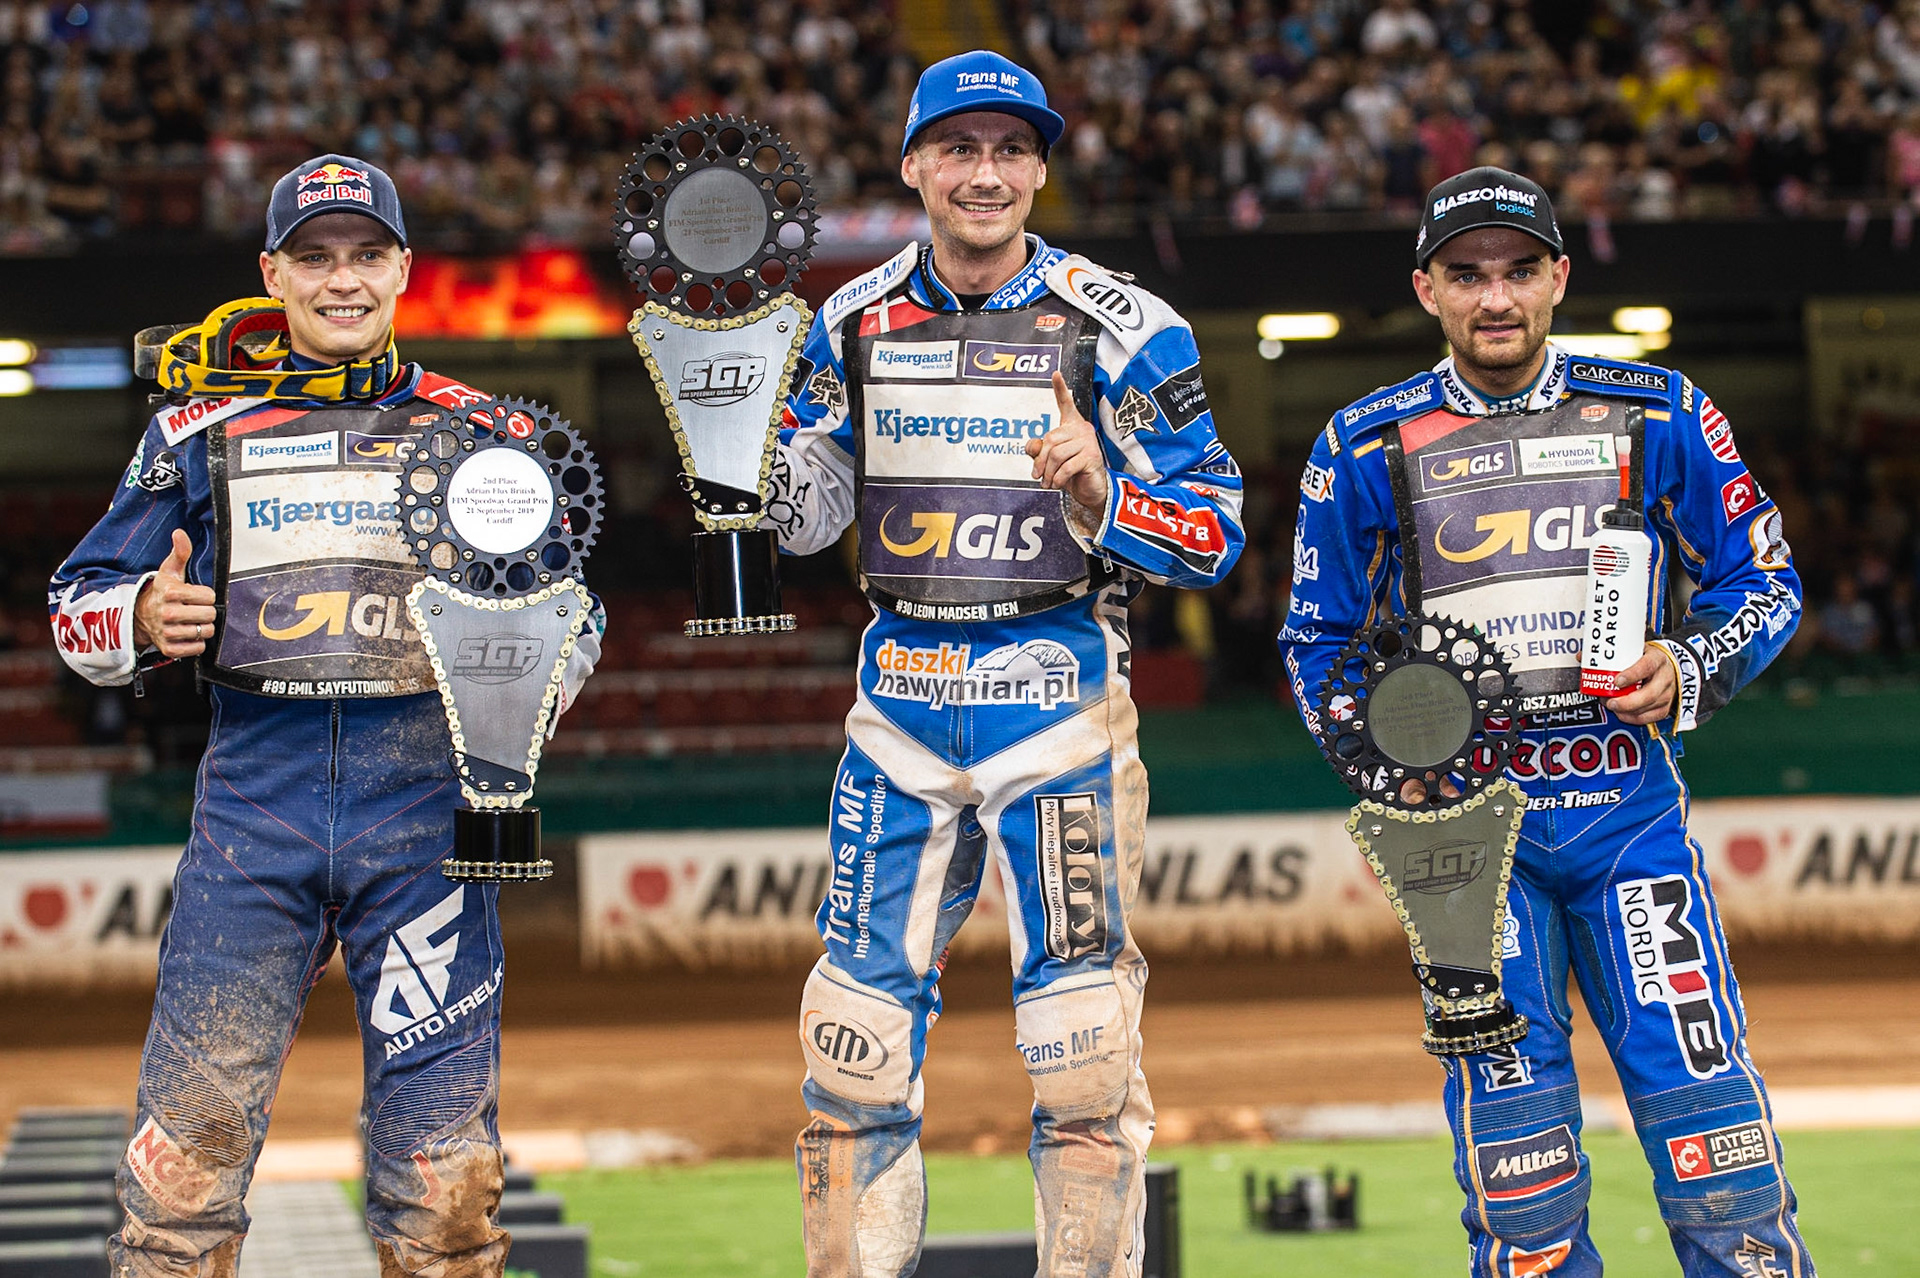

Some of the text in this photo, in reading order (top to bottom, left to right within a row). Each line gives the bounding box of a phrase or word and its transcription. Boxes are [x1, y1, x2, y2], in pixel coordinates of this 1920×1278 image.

[957, 72, 1020, 88] Trans MF
[298, 186, 372, 207] Red Bull
[1495, 202, 1536, 218] logistic
[830, 252, 908, 312] Trans MF
[1001, 252, 1061, 309] GIANT
[876, 350, 954, 367] Kjærgaard
[1014, 354, 1051, 372] GLS
[681, 355, 767, 390] SGP
[1572, 363, 1666, 388] GARCAREK
[874, 408, 1051, 444] Kjærgaard
[248, 439, 333, 458] Kjærgaard
[1548, 448, 1595, 459] HYUNDAI
[1470, 452, 1505, 475] GLS
[1564, 458, 1596, 467] EUROPE
[465, 487, 491, 495] Adrian
[510, 487, 536, 495] British
[498, 477, 519, 485] Place
[452, 497, 549, 506] FIM Speedway Grand Prix
[476, 507, 515, 515] September
[955, 513, 1046, 562] GLS
[896, 599, 1019, 621] #30 LEON MADSEN DEN
[1590, 579, 1605, 668] PROMET
[1604, 588, 1620, 661] CARGO
[878, 642, 966, 675] daszki
[261, 679, 287, 695] #89
[288, 680, 315, 696] EMIL
[316, 680, 396, 696] SAYFUTDINOV
[880, 672, 1075, 706] nawymiar.pl
[822, 769, 867, 946] Trans MF
[853, 773, 886, 960] Internationale Spedition
[1048, 830, 1059, 878] niepalne
[1622, 885, 1663, 999] NORDIC
[384, 1014, 445, 1061] AUTO
[813, 1021, 870, 1063] GM
[1071, 1026, 1104, 1055] MF
[1710, 1127, 1763, 1152] INTER
[1489, 1144, 1570, 1180] Mitas
[1713, 1142, 1767, 1168] CARS
